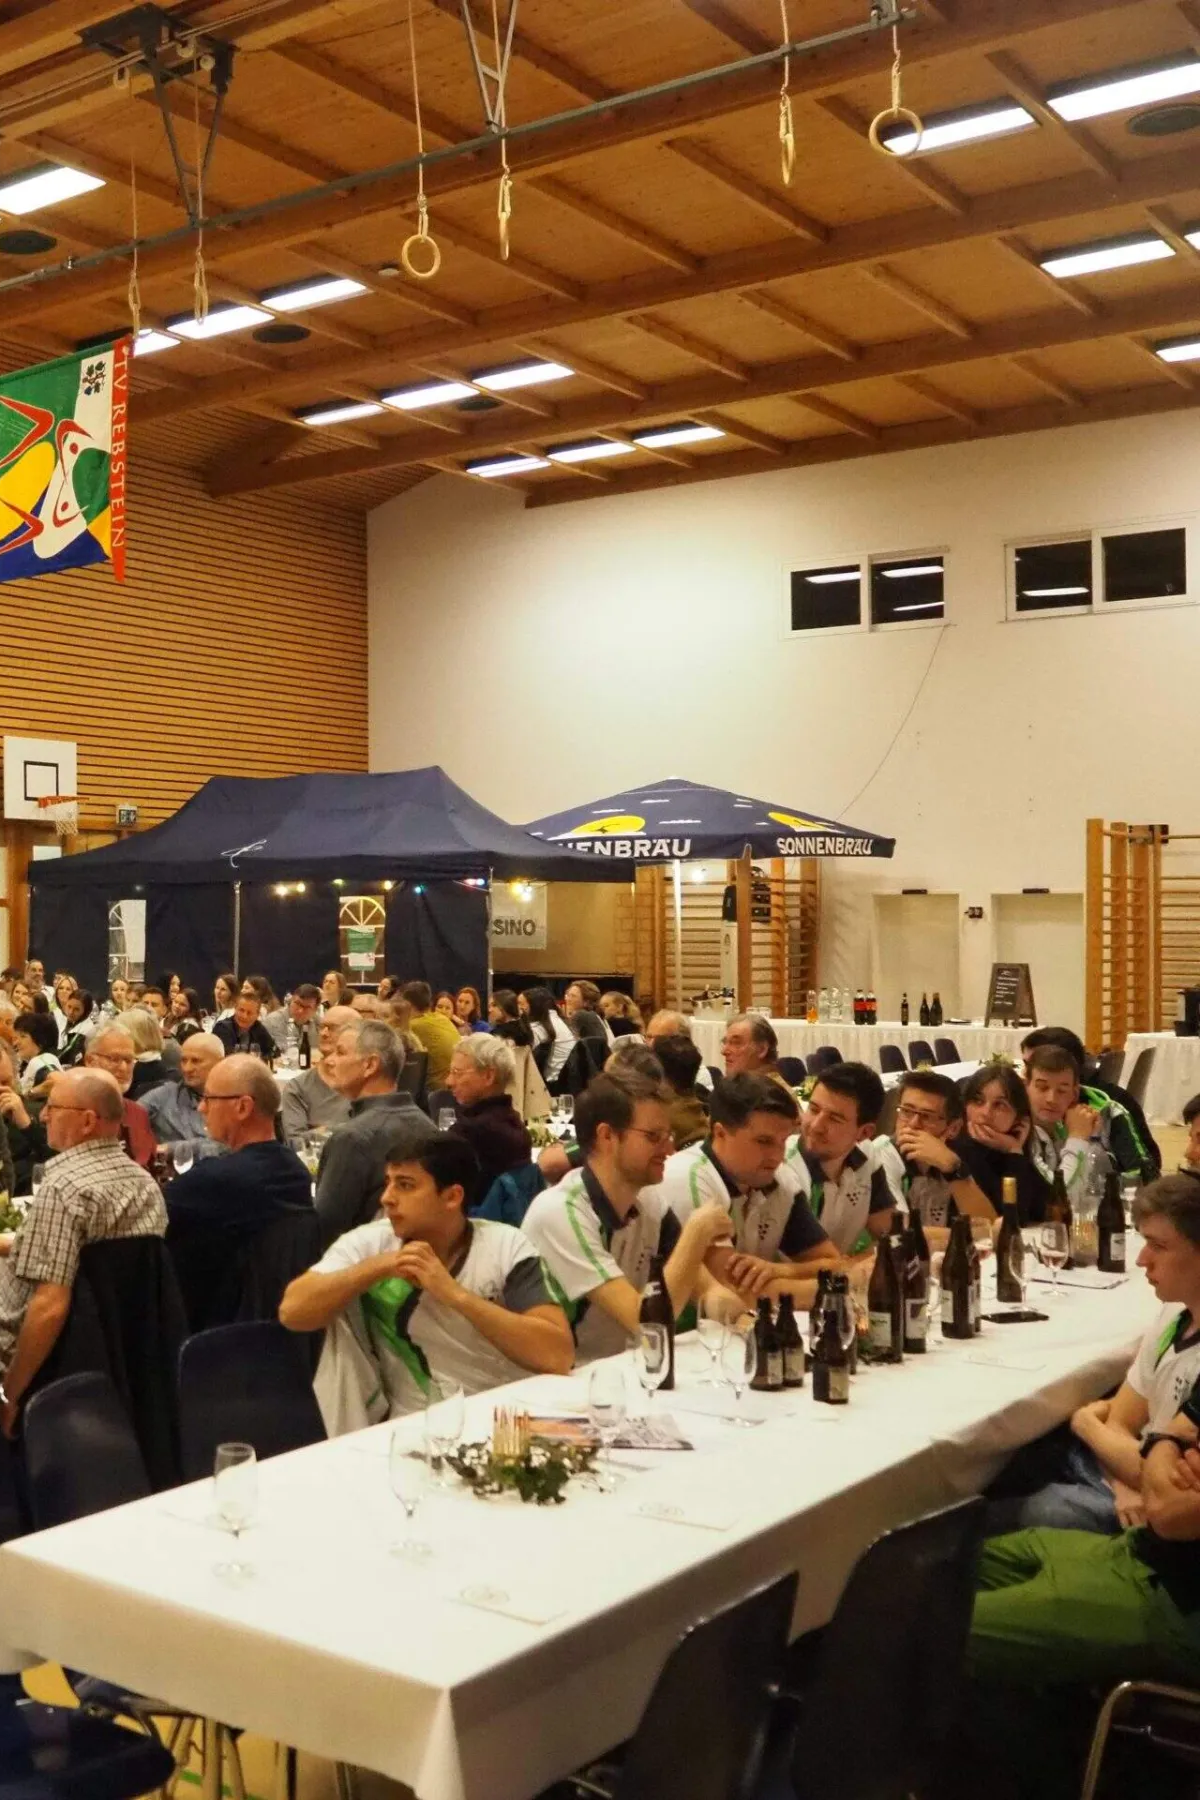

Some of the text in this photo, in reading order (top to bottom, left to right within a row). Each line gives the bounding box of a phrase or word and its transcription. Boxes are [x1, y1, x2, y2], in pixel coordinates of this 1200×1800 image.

[110, 356, 128, 547] TV REBSTEIN
[558, 838, 692, 858] ENBRÄU
[776, 836, 873, 855] SONNENBRÄU
[491, 918, 536, 936] SINO
